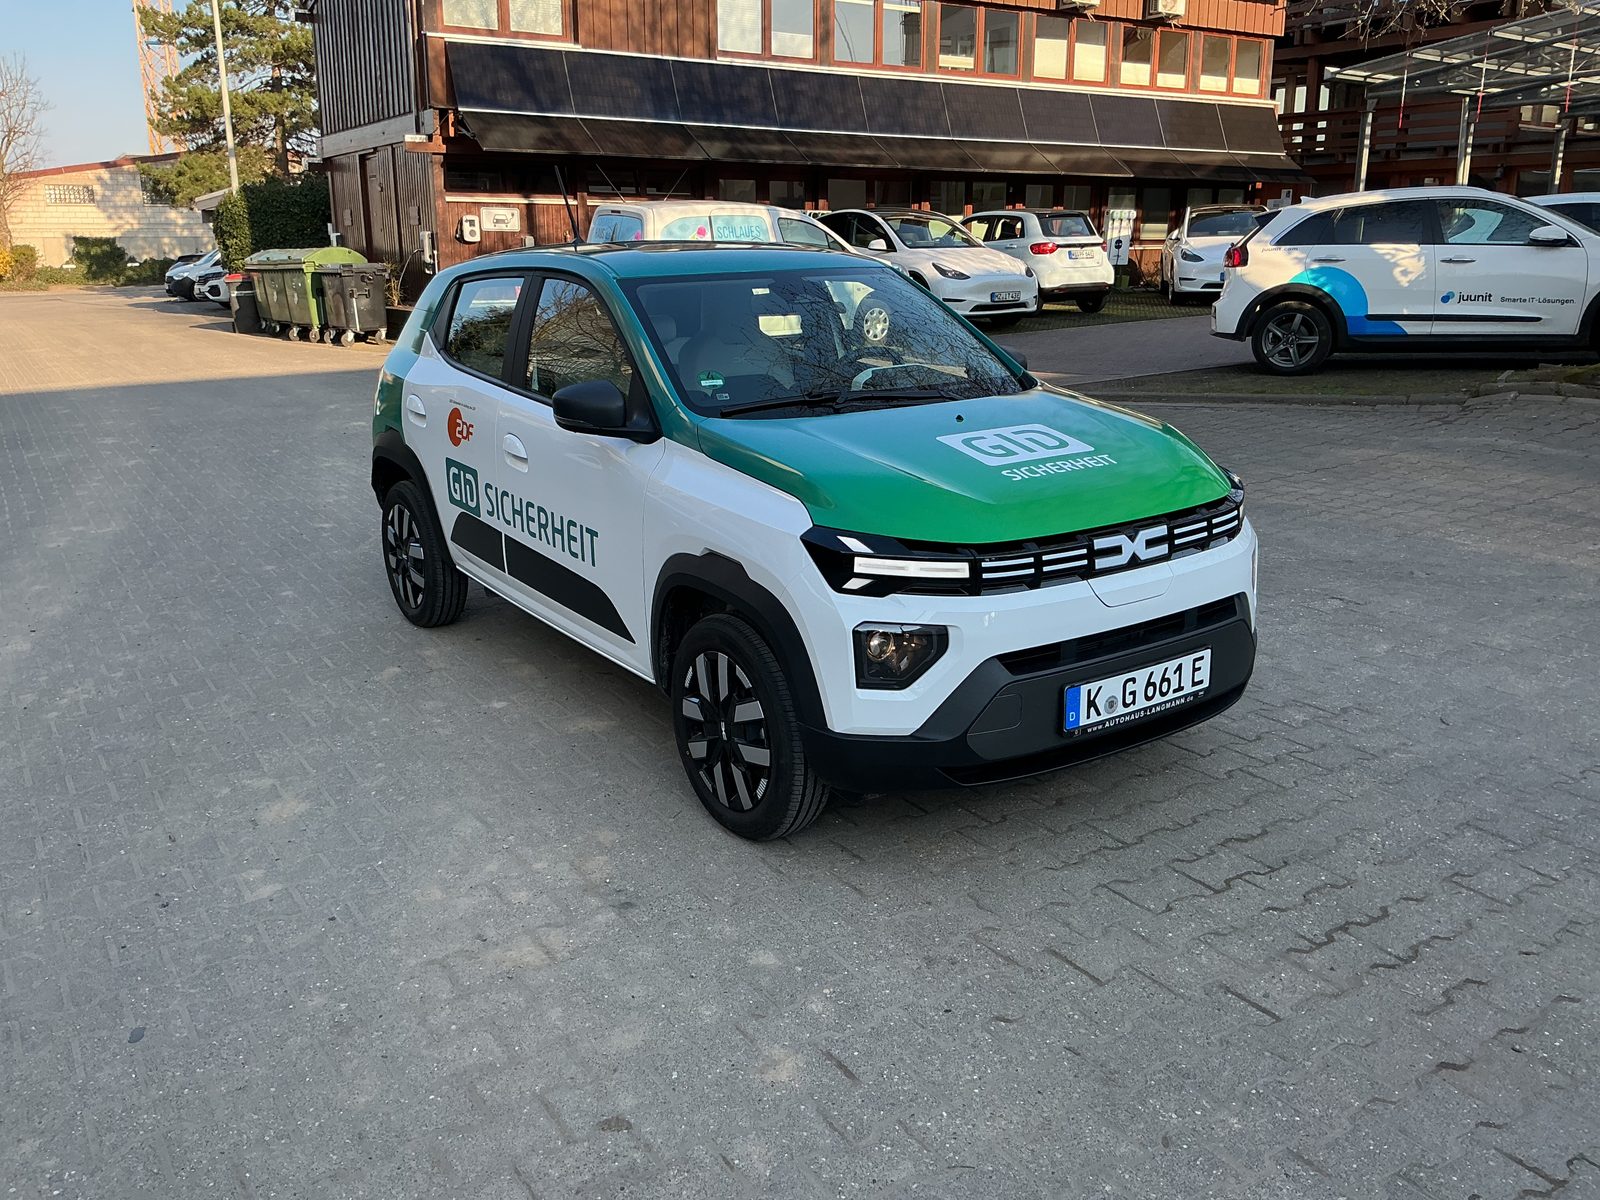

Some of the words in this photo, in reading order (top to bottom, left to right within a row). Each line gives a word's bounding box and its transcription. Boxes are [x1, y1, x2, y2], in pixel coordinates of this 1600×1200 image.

[717, 225, 761, 239] SCHLAUES
[1457, 291, 1492, 304] juunit
[456, 418, 474, 441] ZDF
[1001, 454, 1118, 481] SICHERHEIT
[484, 482, 599, 568] SICHERHEIT
[1069, 711, 1076, 722] D
[1086, 685, 1103, 720] K
[1122, 676, 1137, 709] G
